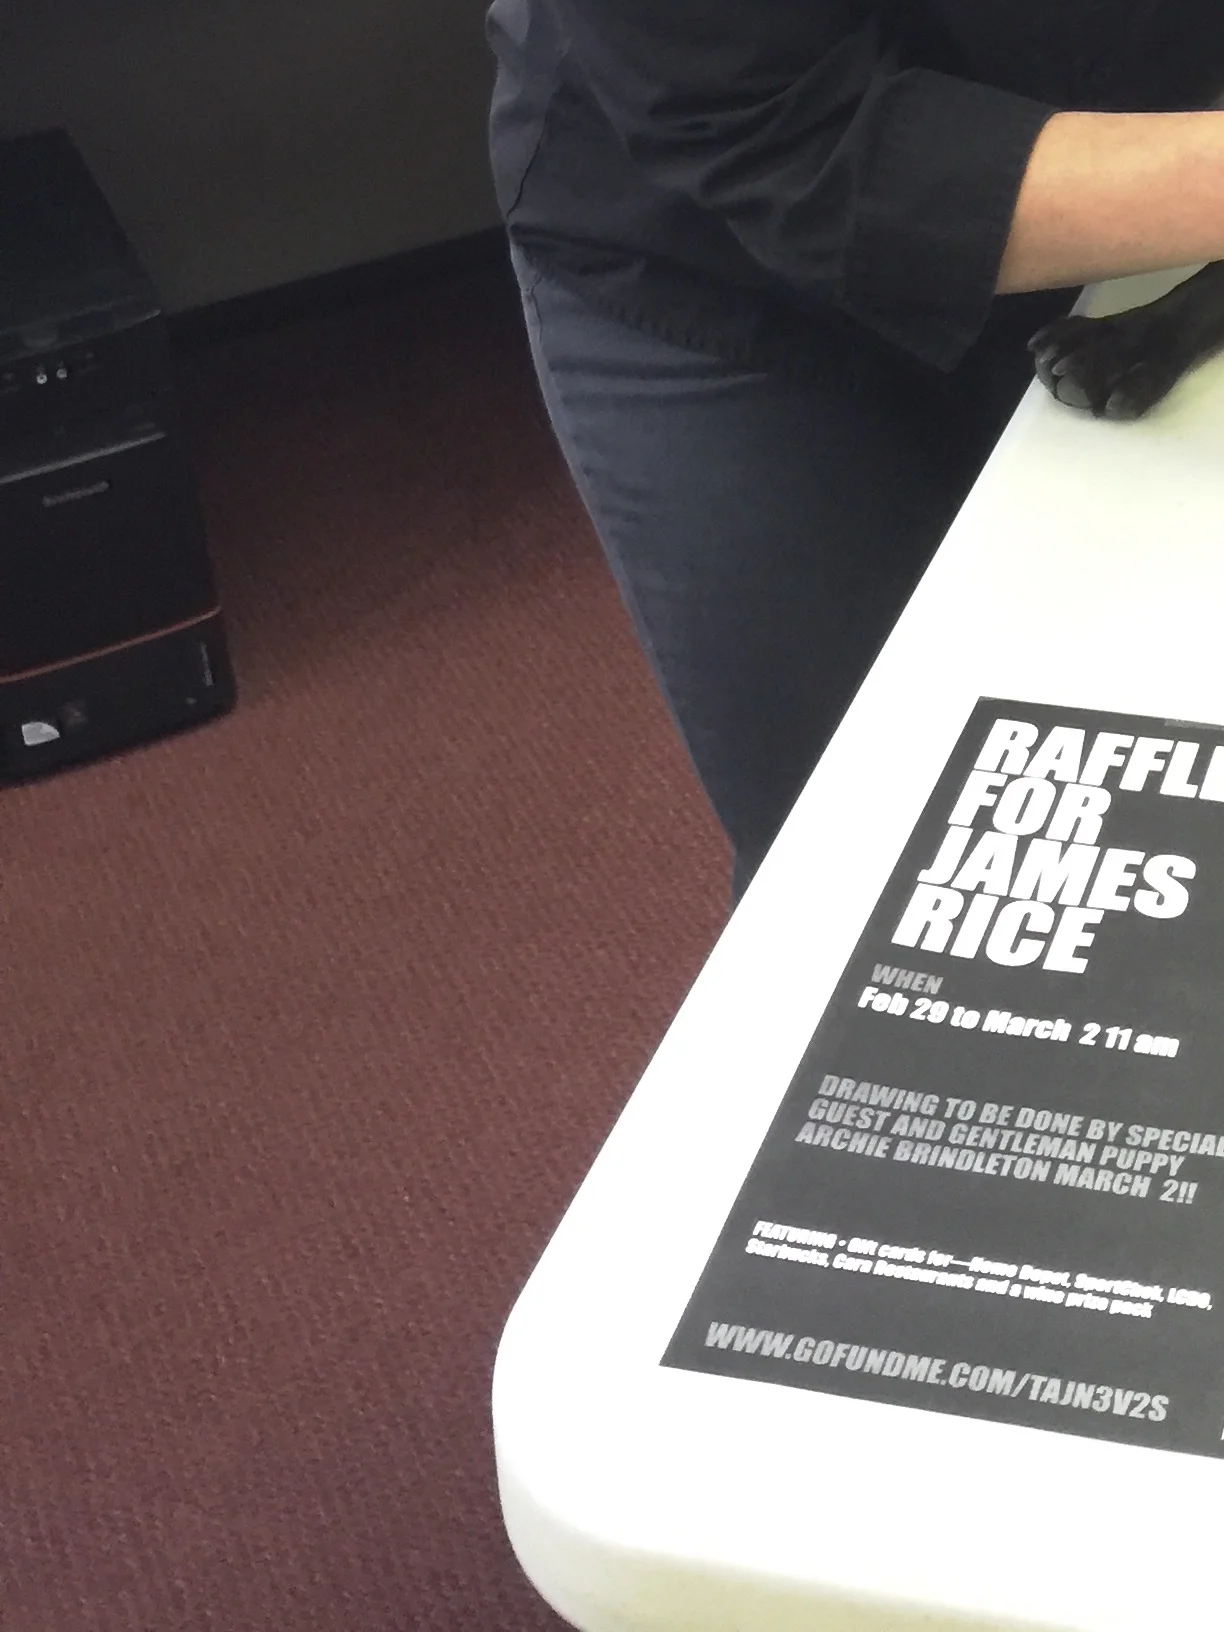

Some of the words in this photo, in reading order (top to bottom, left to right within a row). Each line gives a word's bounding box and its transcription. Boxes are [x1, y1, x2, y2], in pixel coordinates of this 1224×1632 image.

[948, 769, 1112, 845] FOR
[917, 825, 1197, 919] JAMES
[891, 882, 1104, 974] RICE
[871, 963, 944, 995] WHEN
[858, 986, 909, 1016] Feb
[910, 997, 948, 1024] 29
[950, 1006, 981, 1030] to
[982, 1009, 1071, 1042] March
[1079, 1022, 1101, 1047] 2
[1104, 1026, 1133, 1051] 11
[1133, 1034, 1180, 1058] am
[808, 1098, 891, 1132] GUEST
[892, 1114, 947, 1142] AND
[948, 1122, 1097, 1163] GENTLEMAN
[1099, 1146, 1185, 1177] PUPPY
[817, 1074, 940, 1116] DRAWING
[945, 1097, 978, 1121] TO
[979, 1102, 1014, 1126] BE
[1015, 1107, 1085, 1138] DONE
[1086, 1118, 1125, 1144] BY
[795, 1120, 892, 1159] ARCHIE
[892, 1140, 1052, 1182] BRINDLETON
[1053, 1163, 1150, 1198] MARCH
[1159, 1179, 1199, 1205] 2!!
[752, 1220, 838, 1249] FEATURING
[704, 1321, 1170, 1423] WWW.GOFUNDME.COM/TAJN3V2S
